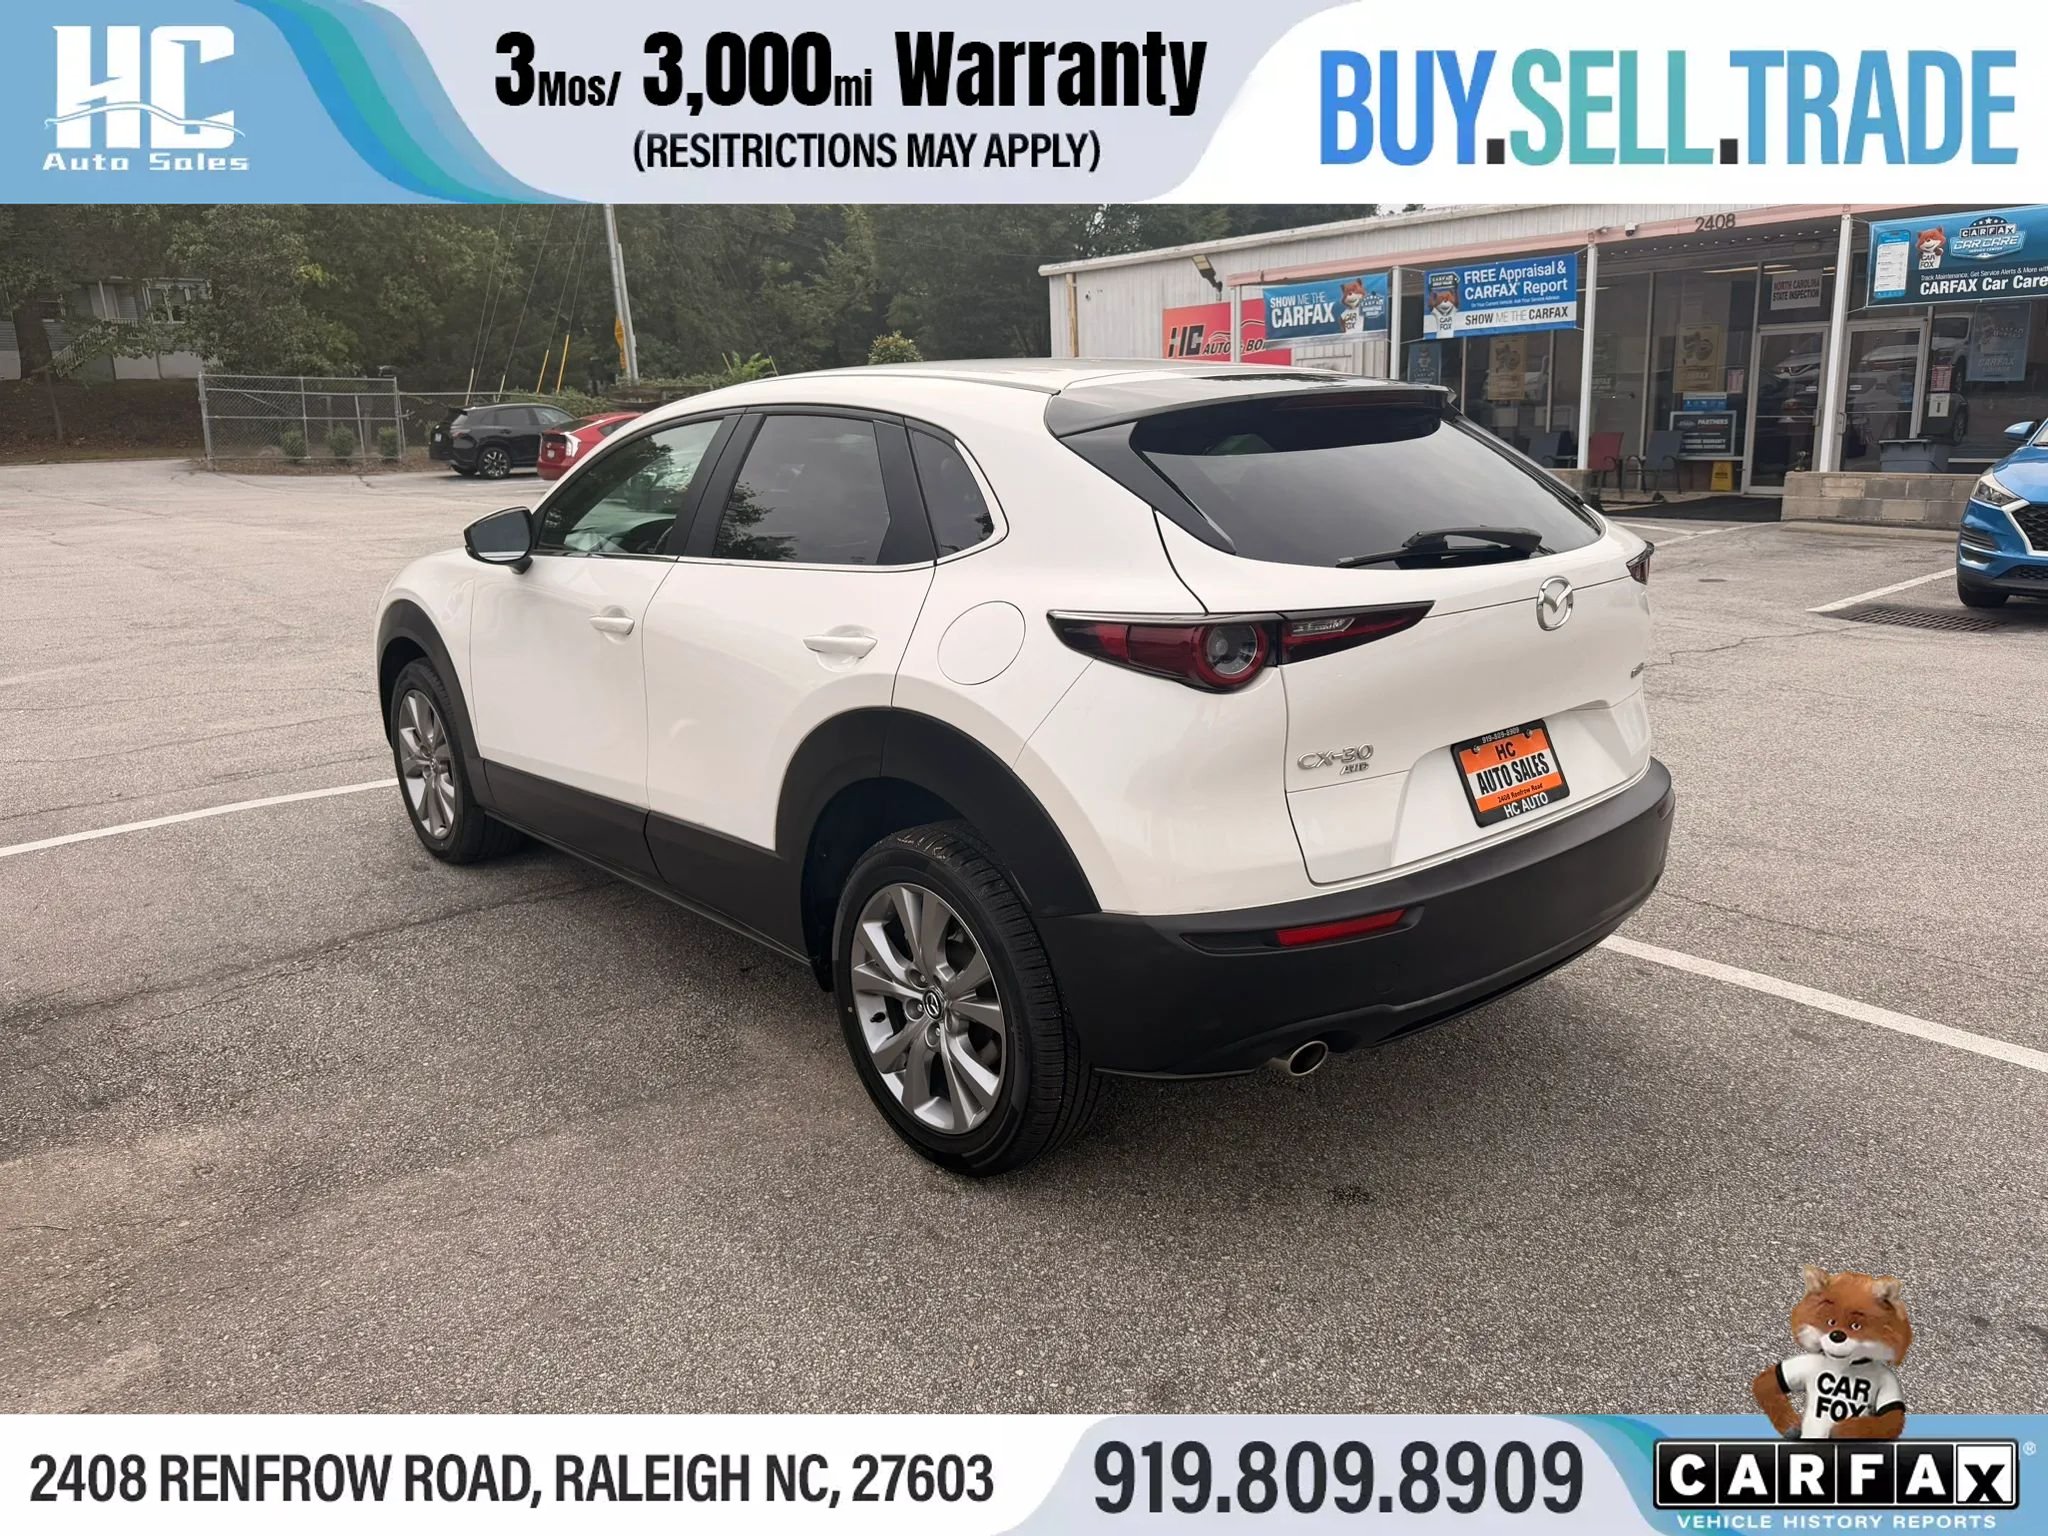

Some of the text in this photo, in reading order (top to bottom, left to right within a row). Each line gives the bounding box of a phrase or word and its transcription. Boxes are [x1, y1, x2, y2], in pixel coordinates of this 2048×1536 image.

[1695, 213, 1736, 232] 2408
[1962, 224, 2017, 238] CARFAX
[1954, 235, 2020, 249] CAR CARE
[1920, 253, 1936, 261] CAR
[1464, 260, 1567, 284] FREE Appraisal &
[1970, 270, 1979, 278] Get
[1980, 269, 2000, 277] Service
[1464, 278, 1568, 300] CARFAX Report
[1920, 274, 2048, 295] CARFAX Car Care
[1270, 291, 1327, 308] SHOW ME THE
[1773, 289, 1820, 301] STATE INSPECTION
[1271, 302, 1336, 328] CARFAX
[1465, 306, 1569, 326] SHOW ME THE CARFAX
[1168, 325, 1205, 358] HC
[1202, 340, 1231, 355] AUTO
[1297, 743, 1374, 770] CX-30
[1495, 741, 1516, 760] HC
[1476, 752, 1550, 796] AUTO SALES
[1503, 792, 1549, 818] HC AUTO
